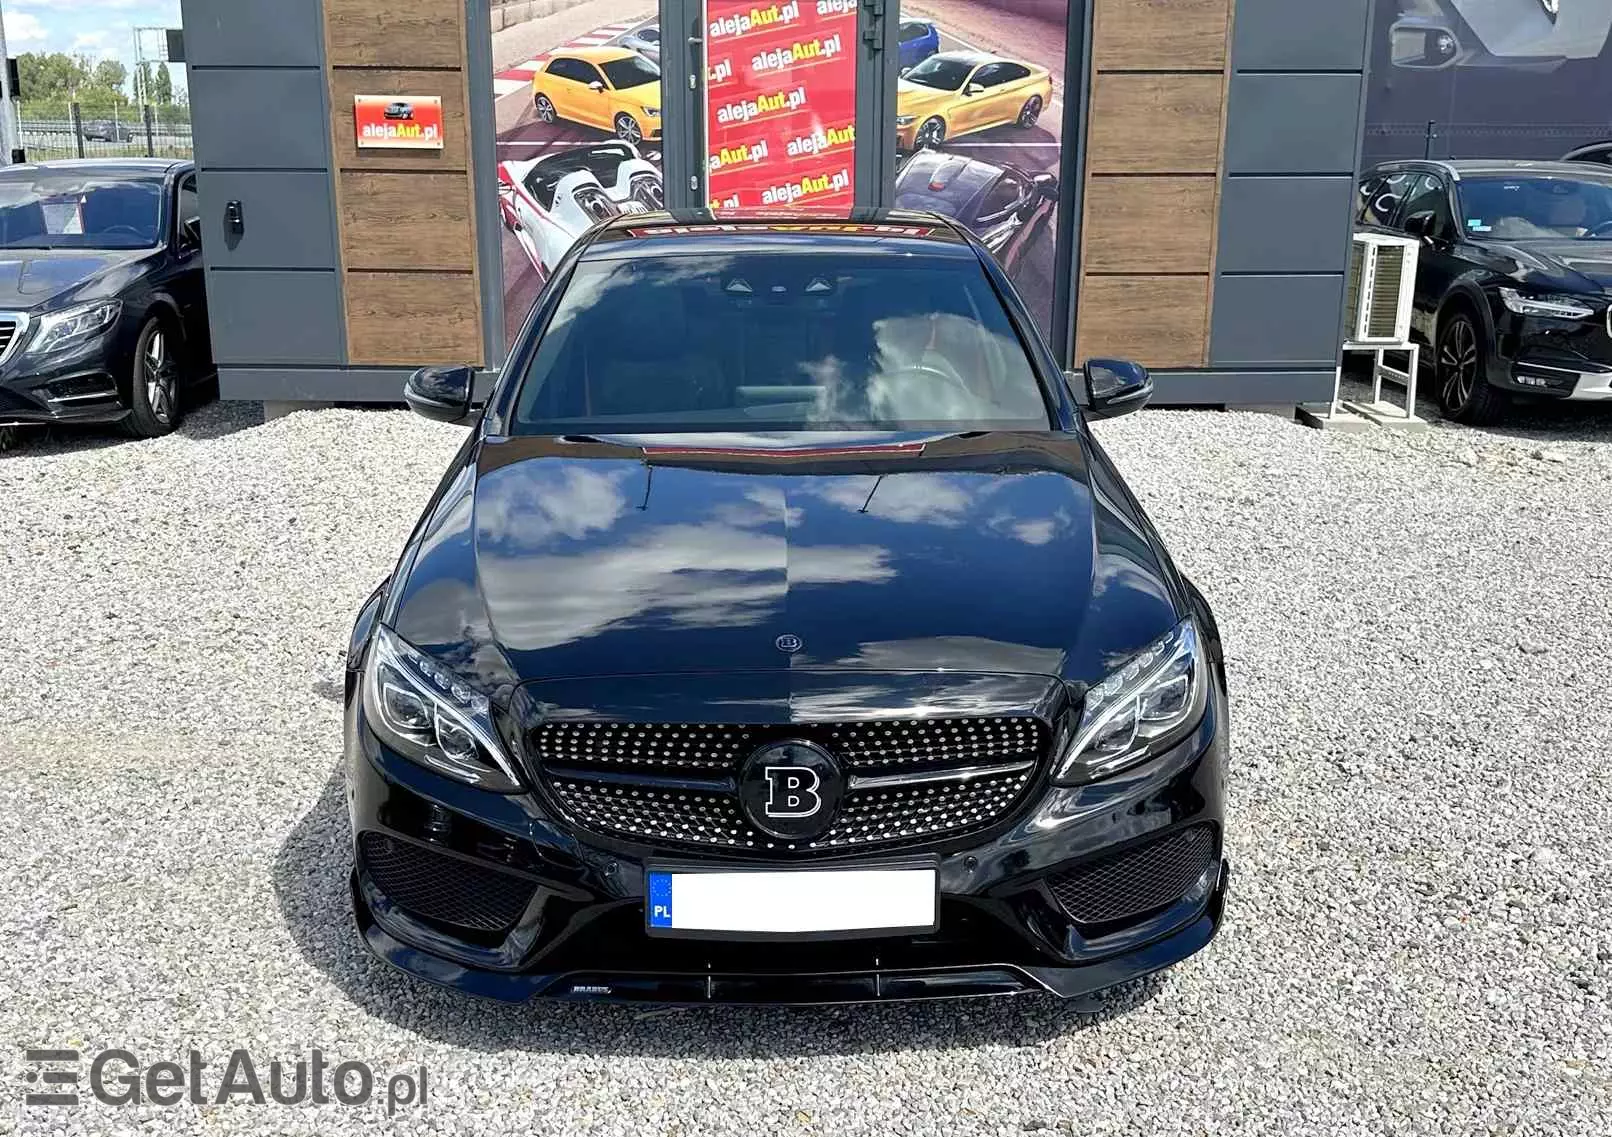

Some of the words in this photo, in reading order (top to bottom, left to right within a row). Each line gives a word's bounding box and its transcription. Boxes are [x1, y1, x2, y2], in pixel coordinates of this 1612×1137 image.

[710, 1, 800, 37] alejaAut.pl
[752, 34, 841, 71] alejaAut.pl
[717, 87, 807, 123] alejaAut.pl
[362, 123, 438, 141] alejaAut.pl
[709, 140, 769, 172] aAut.pl
[762, 168, 849, 205] alejaAut.pl
[765, 766, 822, 818] B
[654, 905, 671, 918] PL
